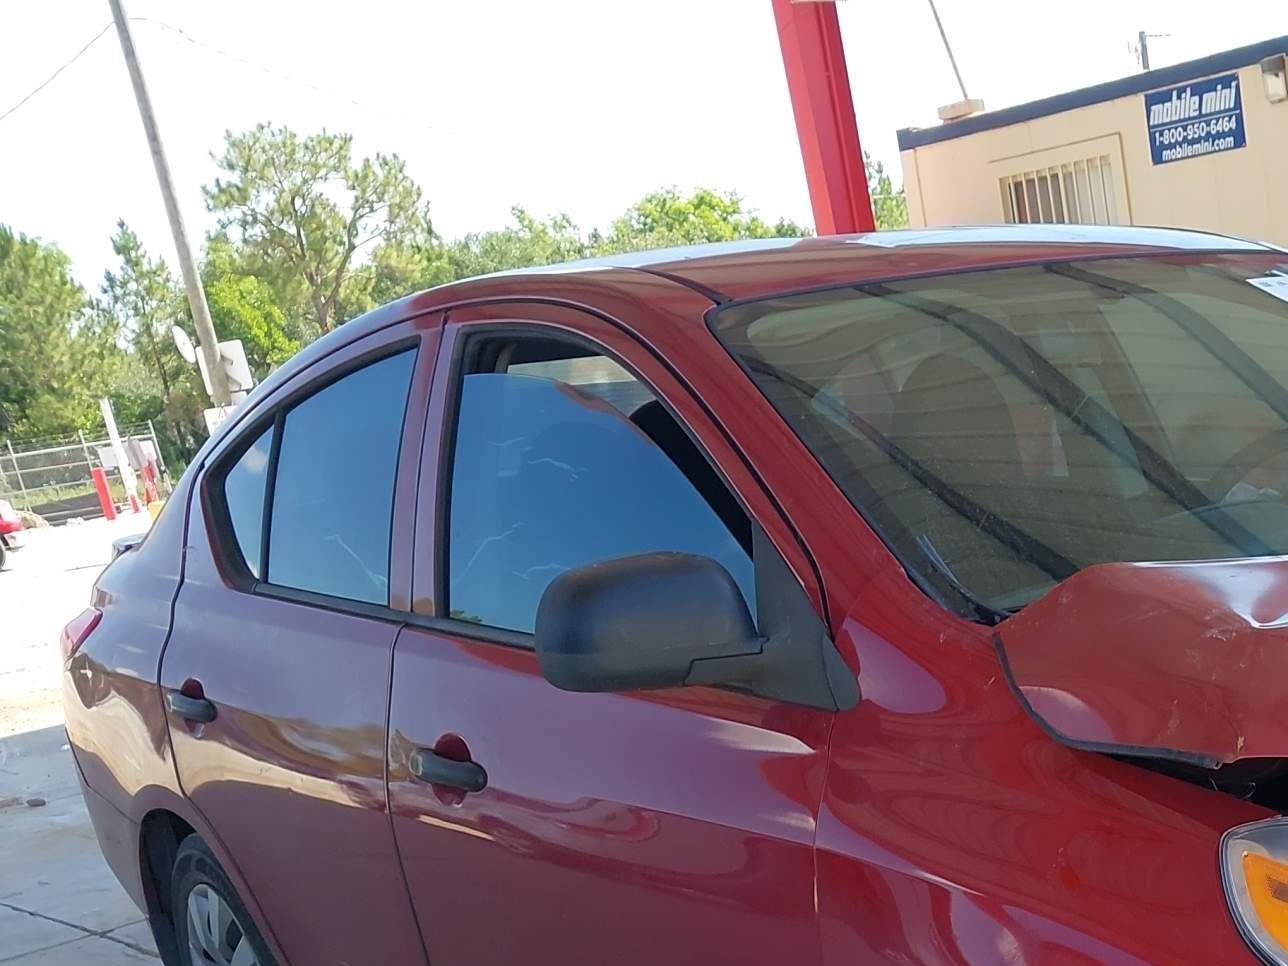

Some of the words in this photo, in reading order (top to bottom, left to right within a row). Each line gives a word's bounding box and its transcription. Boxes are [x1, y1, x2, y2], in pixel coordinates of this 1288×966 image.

[1149, 87, 1200, 125] mobile
[1201, 80, 1238, 115] mini
[1155, 115, 1236, 146] 1-800-950-6464
[1162, 137, 1234, 161] mobilemini.com
